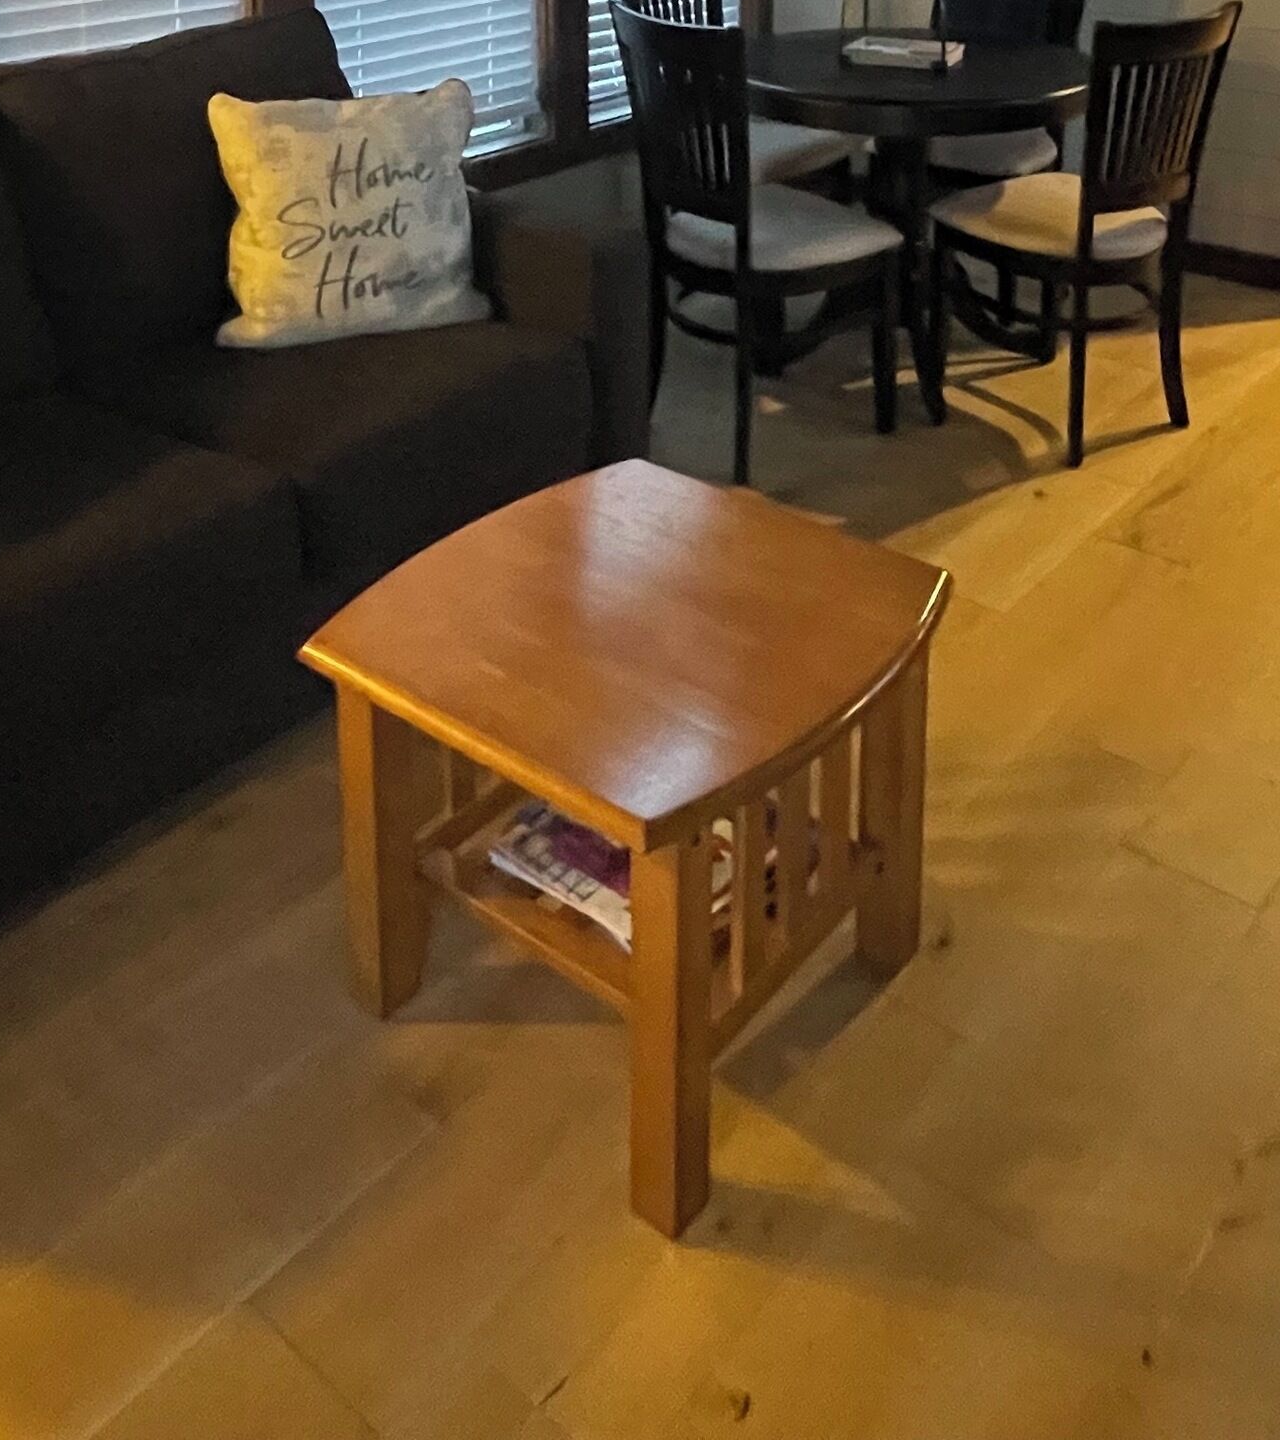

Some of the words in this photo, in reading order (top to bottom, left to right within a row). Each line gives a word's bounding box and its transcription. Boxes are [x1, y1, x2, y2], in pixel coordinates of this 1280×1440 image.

[326, 137, 434, 208] Home
[276, 197, 408, 260] Sweet
[314, 245, 421, 318] Home
